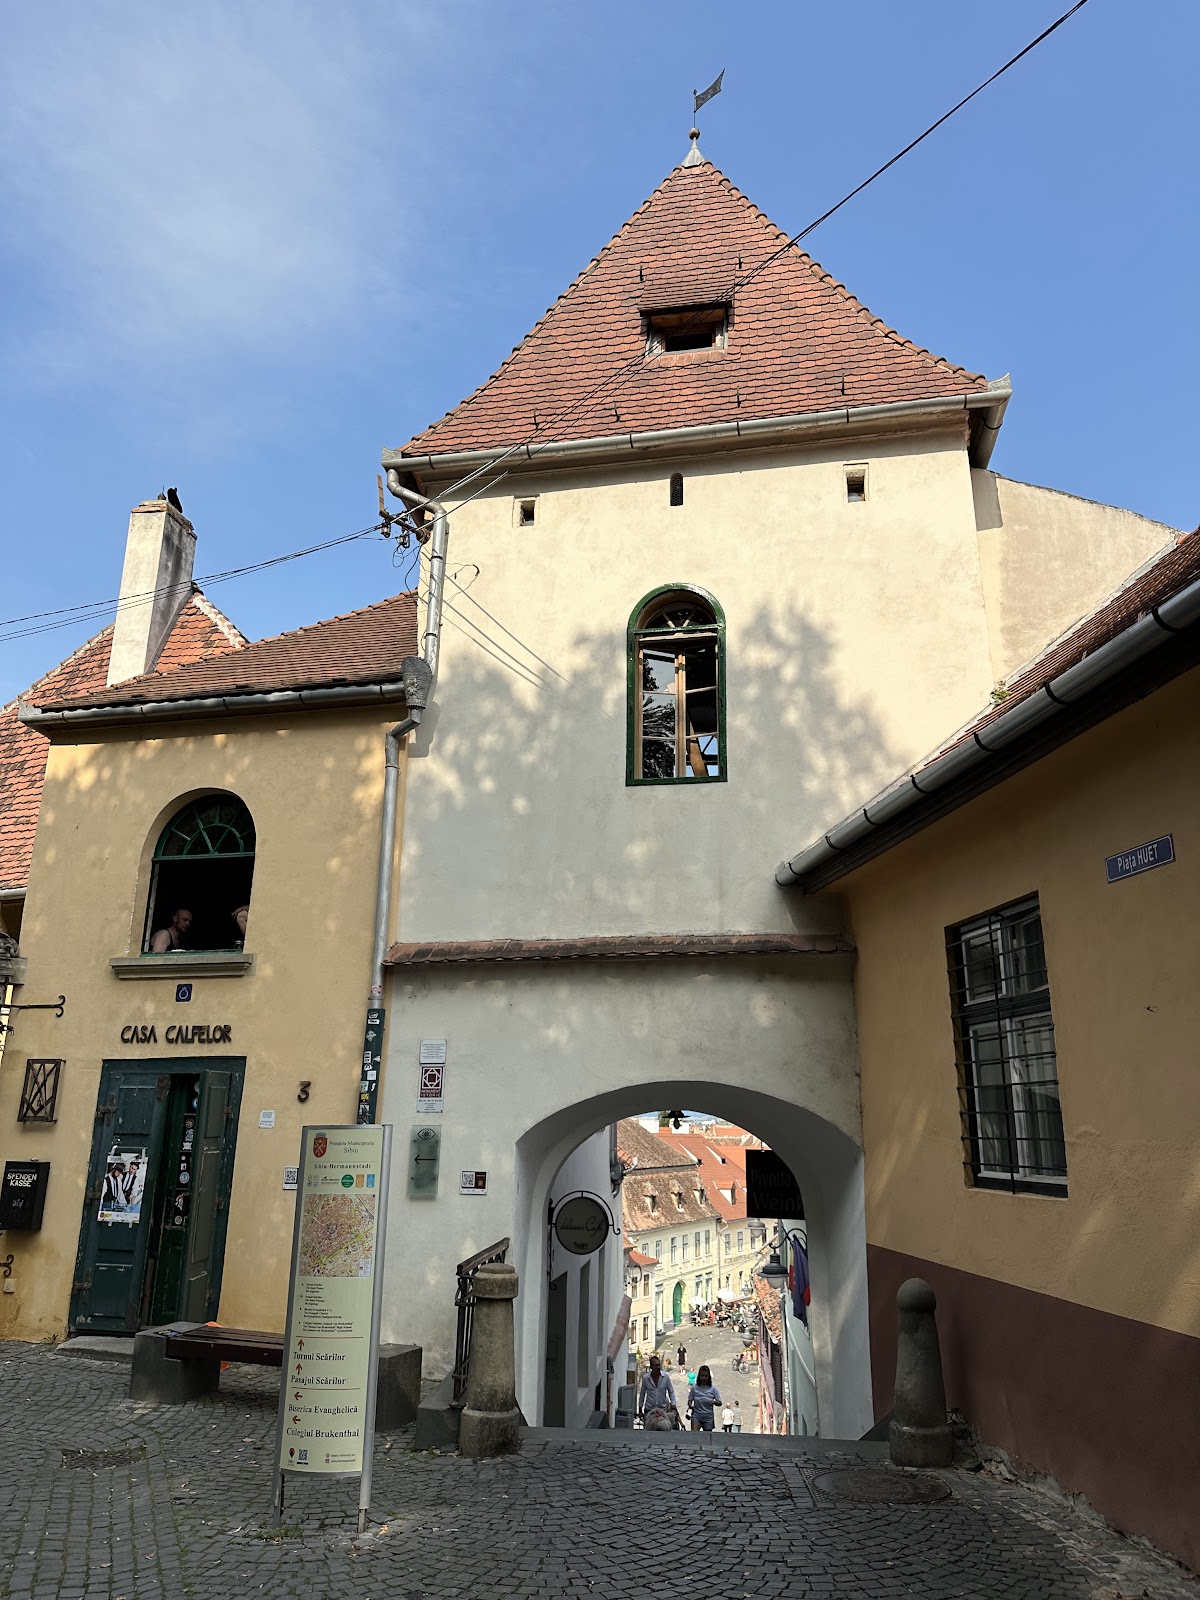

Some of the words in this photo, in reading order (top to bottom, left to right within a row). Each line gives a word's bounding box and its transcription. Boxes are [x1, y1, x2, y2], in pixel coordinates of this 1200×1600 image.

[1137, 844, 1158, 865] HUET
[120, 1024, 158, 1044] CASA
[165, 1024, 232, 1044] CALFELOR
[297, 1080, 312, 1103] 3
[7, 1172, 38, 1181] SPENDEN
[10, 1180, 32, 1188] KASSE
[293, 1351, 314, 1360] Turnul
[315, 1352, 346, 1361] Scărilor
[290, 1374, 314, 1386] Pasajul
[315, 1376, 347, 1385] Scărilor
[288, 1403, 312, 1413] Biserica
[314, 1405, 358, 1416] Evanghelică
[286, 1427, 313, 1439] Colegiul
[315, 1428, 360, 1438] Brukenthal
